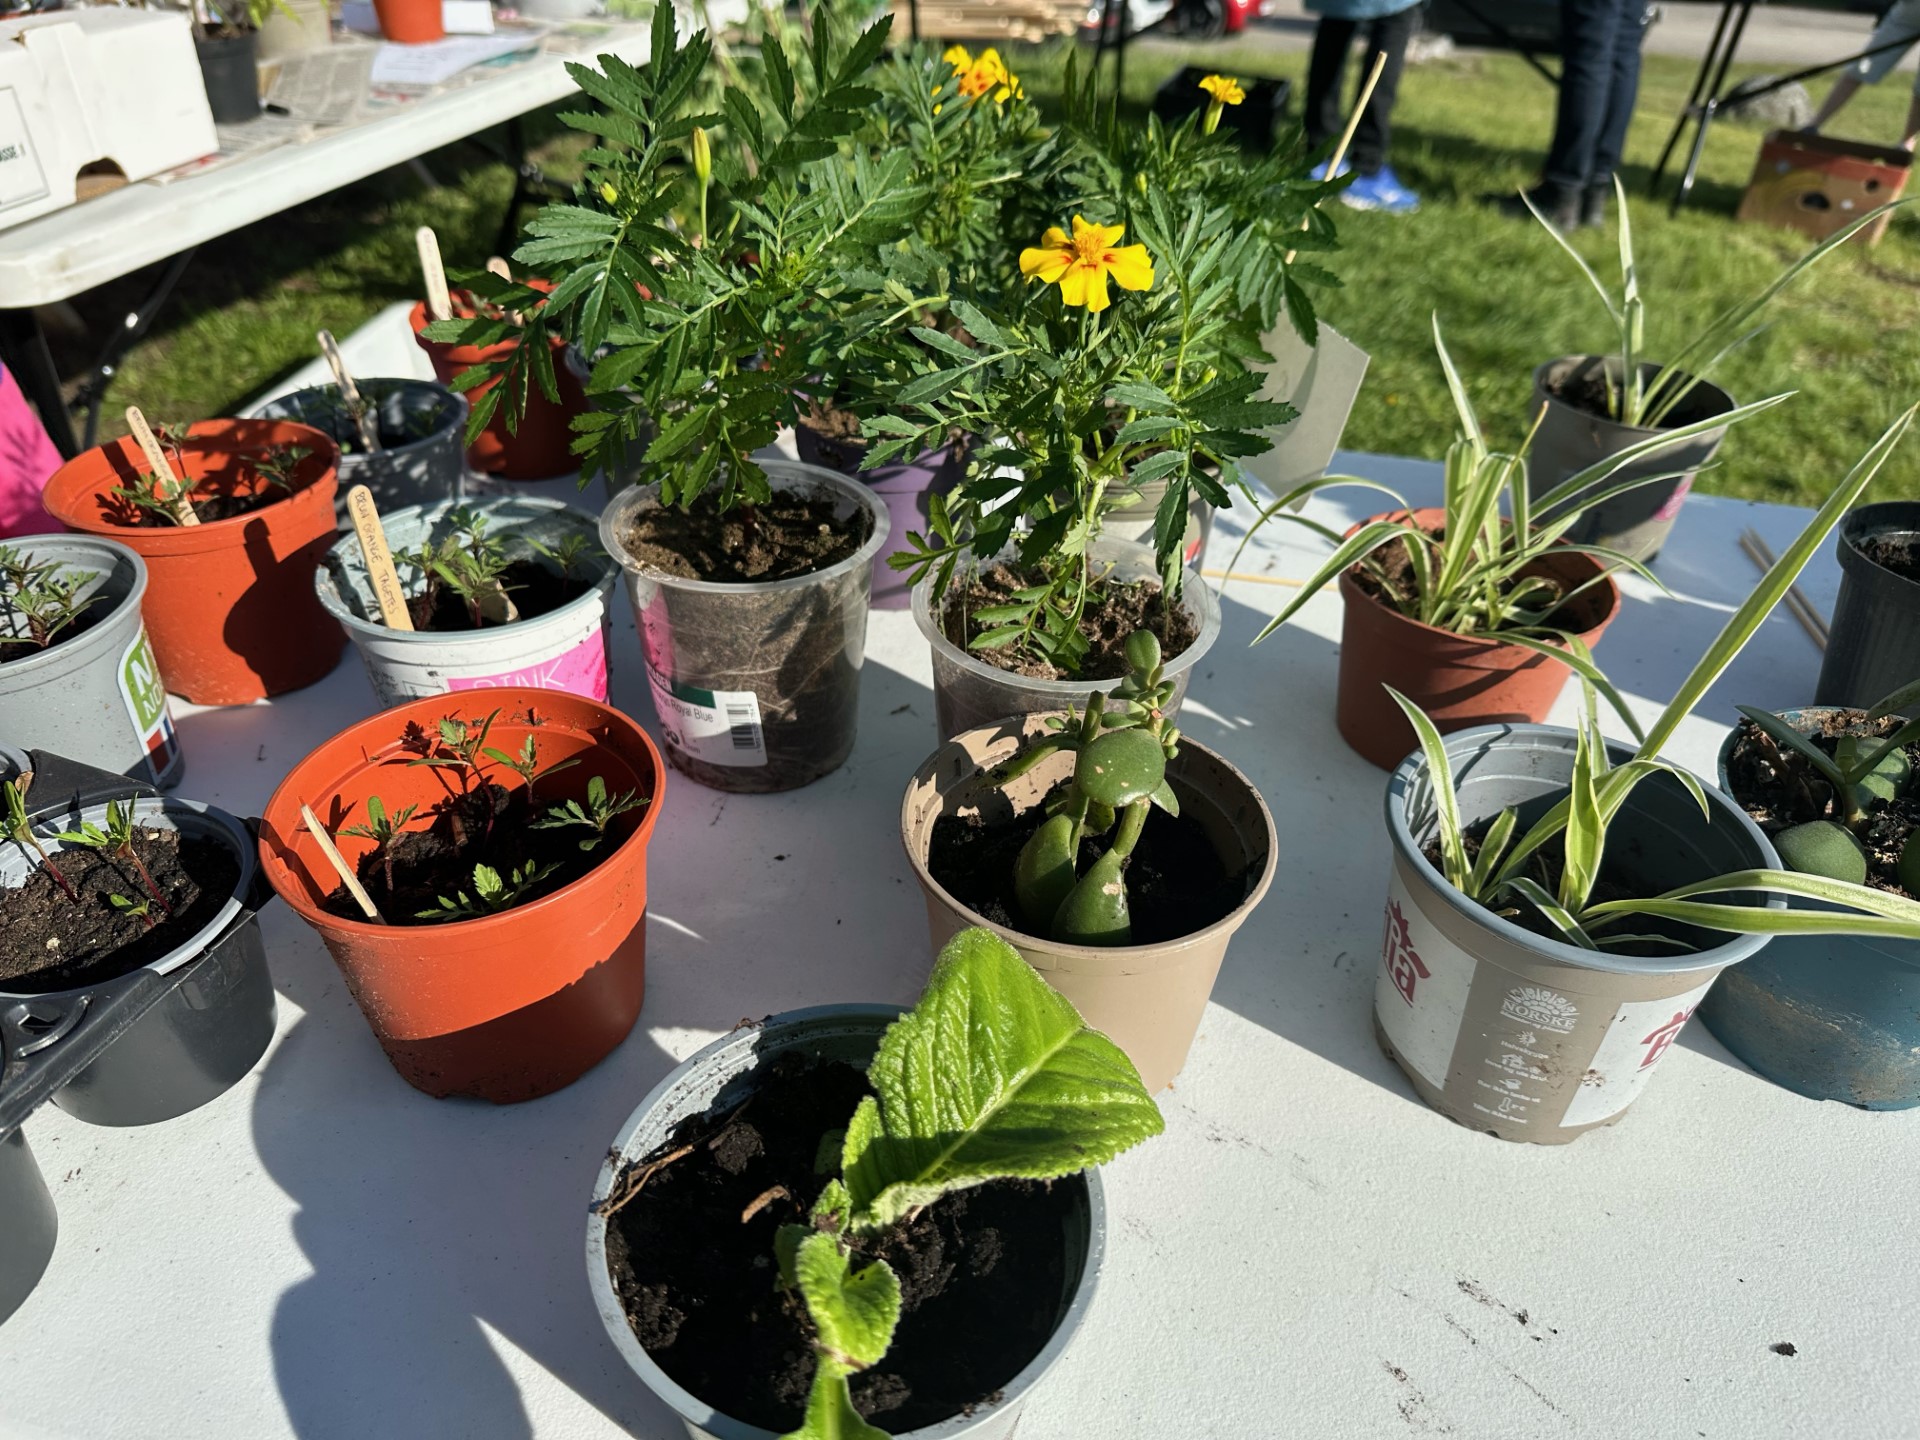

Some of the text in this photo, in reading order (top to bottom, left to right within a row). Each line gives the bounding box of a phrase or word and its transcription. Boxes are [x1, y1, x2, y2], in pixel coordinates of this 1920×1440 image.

[354, 491, 399, 615] BRUN ORANGE TAGETES
[671, 699, 714, 723] Royal Blue
[1502, 1000, 1576, 1029] NORSKE
